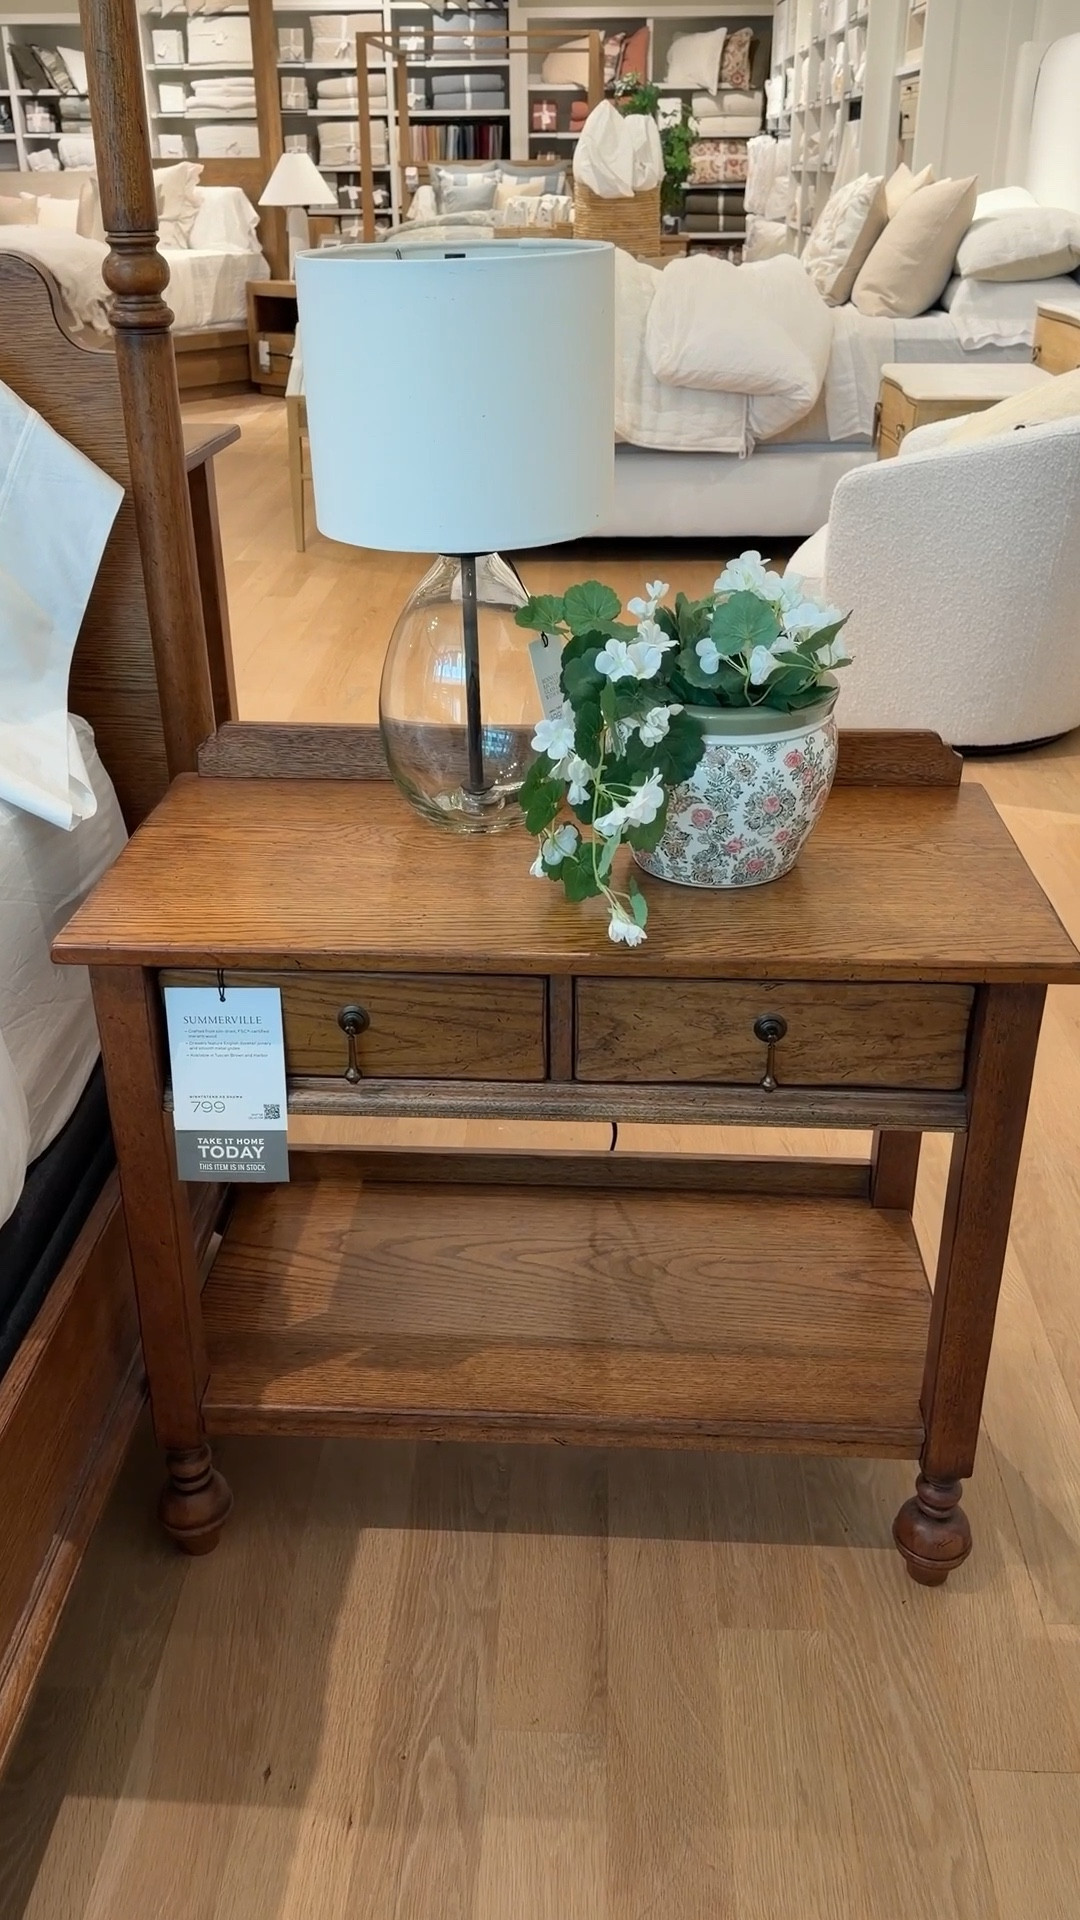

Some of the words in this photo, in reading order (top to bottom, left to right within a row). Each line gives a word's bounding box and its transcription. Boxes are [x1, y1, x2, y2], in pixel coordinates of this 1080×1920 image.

[183, 1015, 262, 1025] SUMMERVILLE
[190, 1100, 226, 1113] 799
[197, 1145, 265, 1159] TODAY
